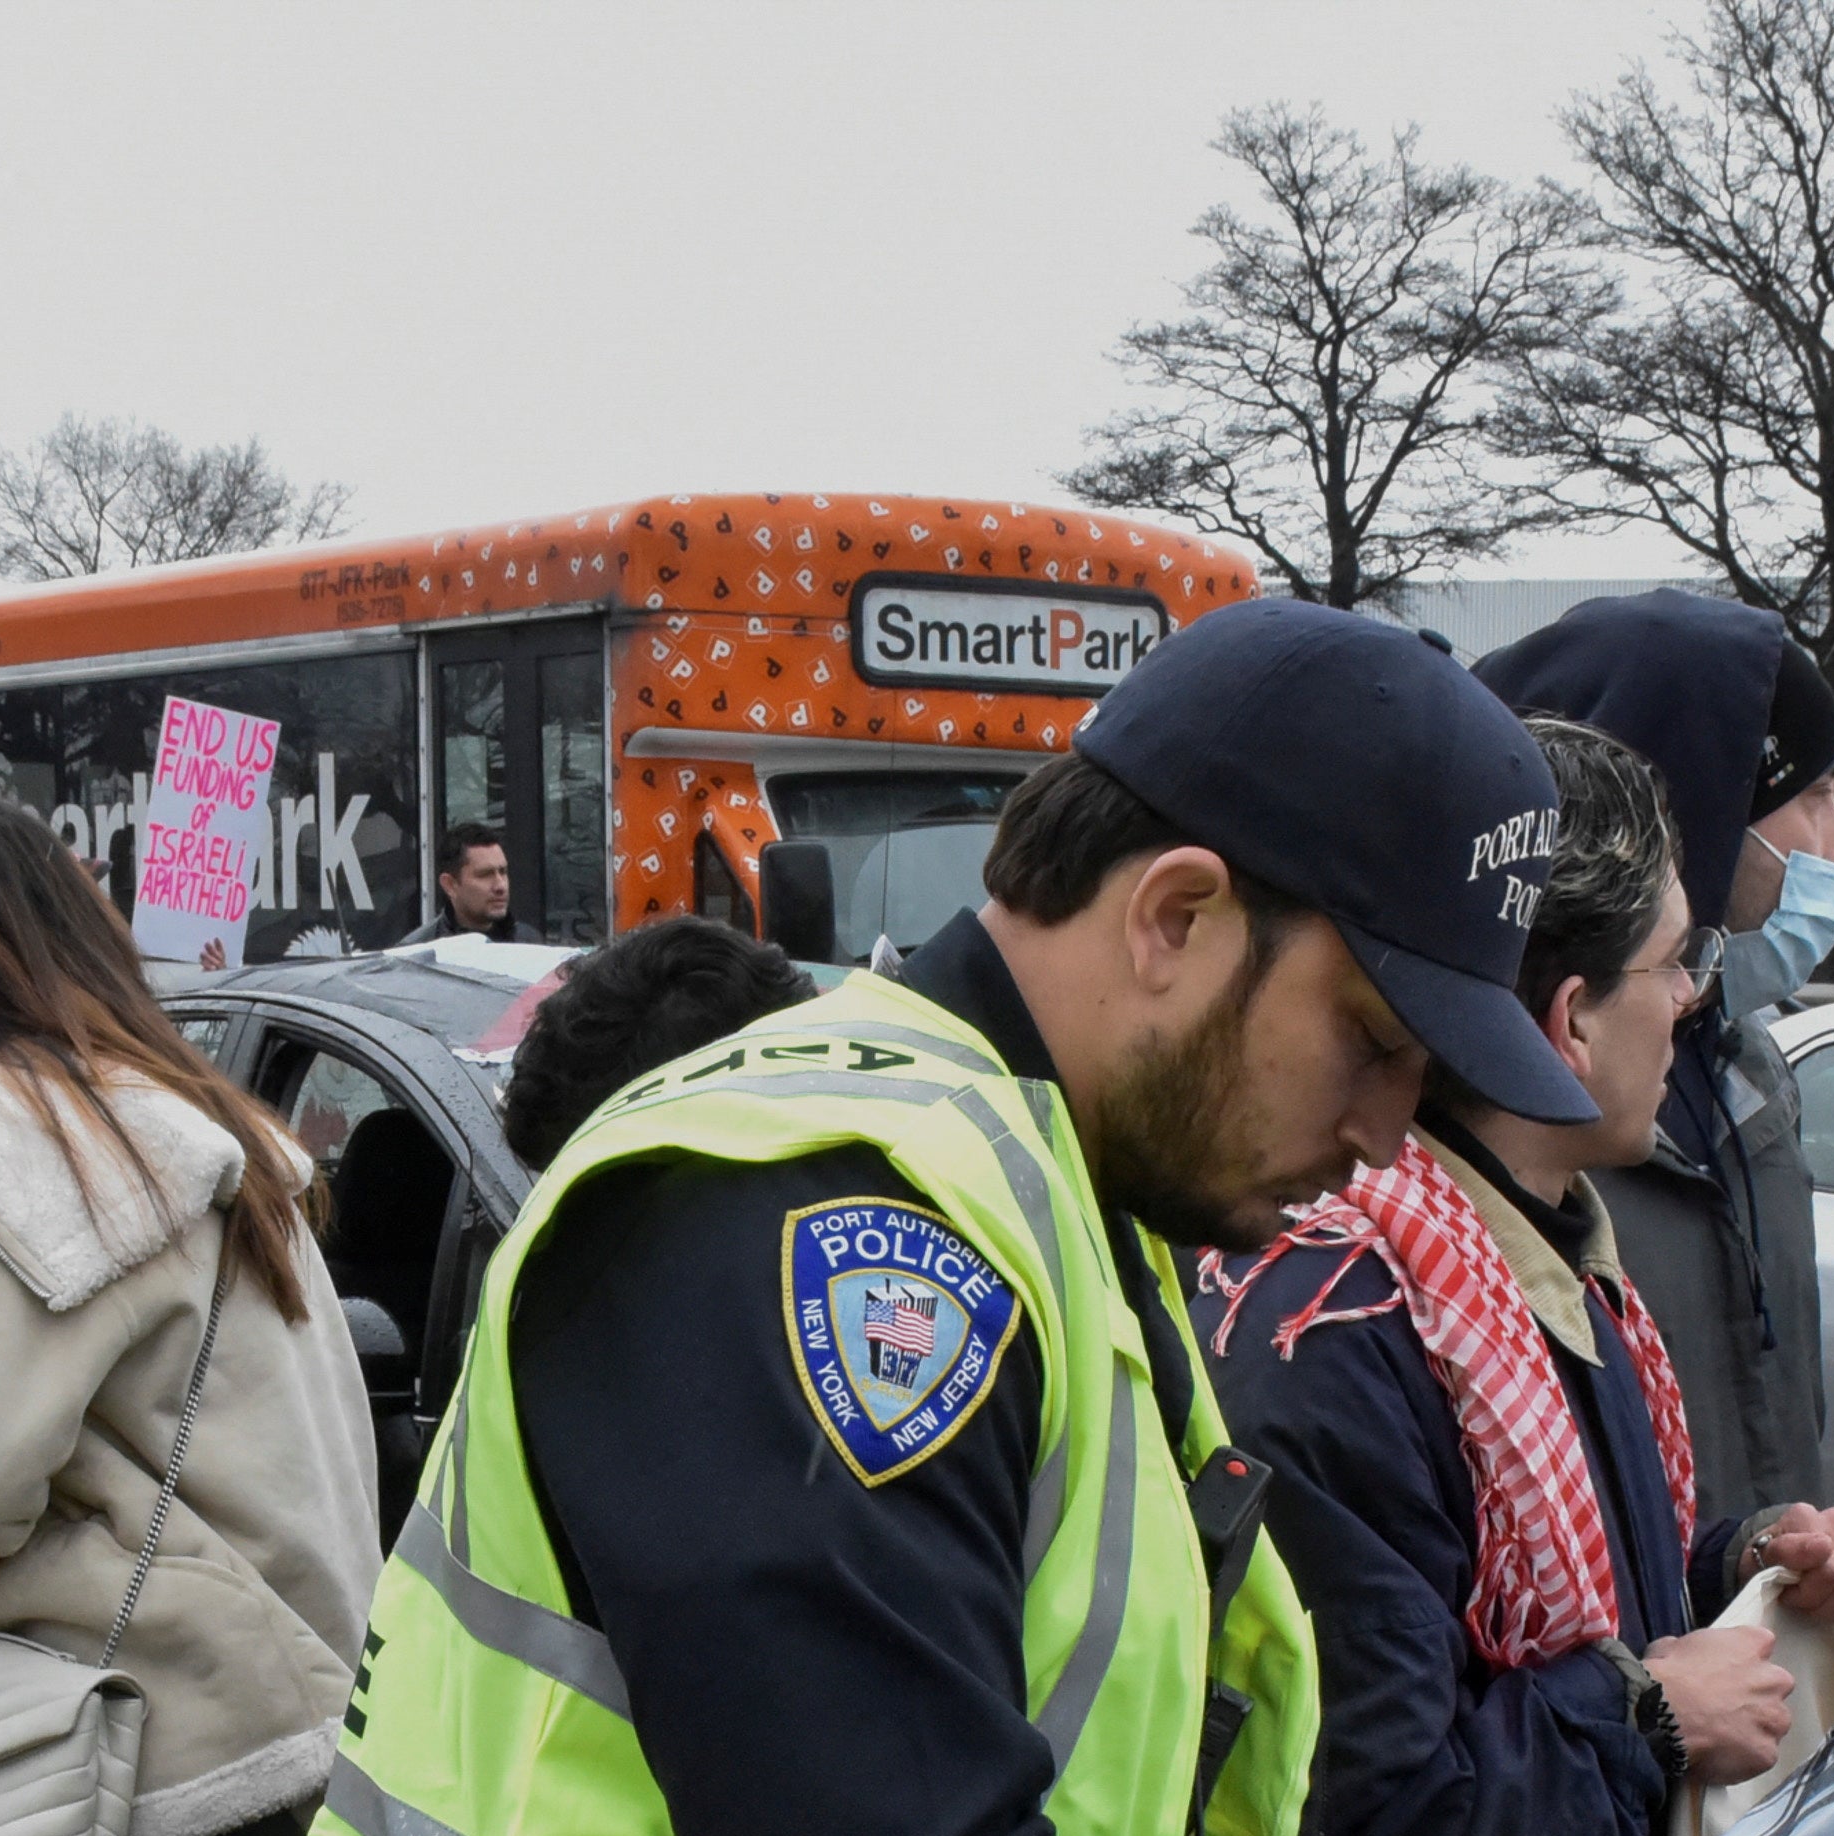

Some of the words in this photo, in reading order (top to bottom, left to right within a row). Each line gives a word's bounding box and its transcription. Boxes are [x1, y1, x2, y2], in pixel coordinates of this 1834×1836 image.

[876, 603, 1157, 671] SmartPark
[163, 700, 227, 756] END
[235, 719, 277, 773] US
[1467, 809, 1536, 882] PORT
[810, 1210, 875, 1239] PORT
[885, 1213, 1004, 1287] AUTHORITY
[820, 1228, 992, 1310] POLICE
[801, 1298, 830, 1351] NEW
[817, 1360, 860, 1428] YORK
[891, 1406, 940, 1453] NEW
[942, 1333, 987, 1413] JERSEY
